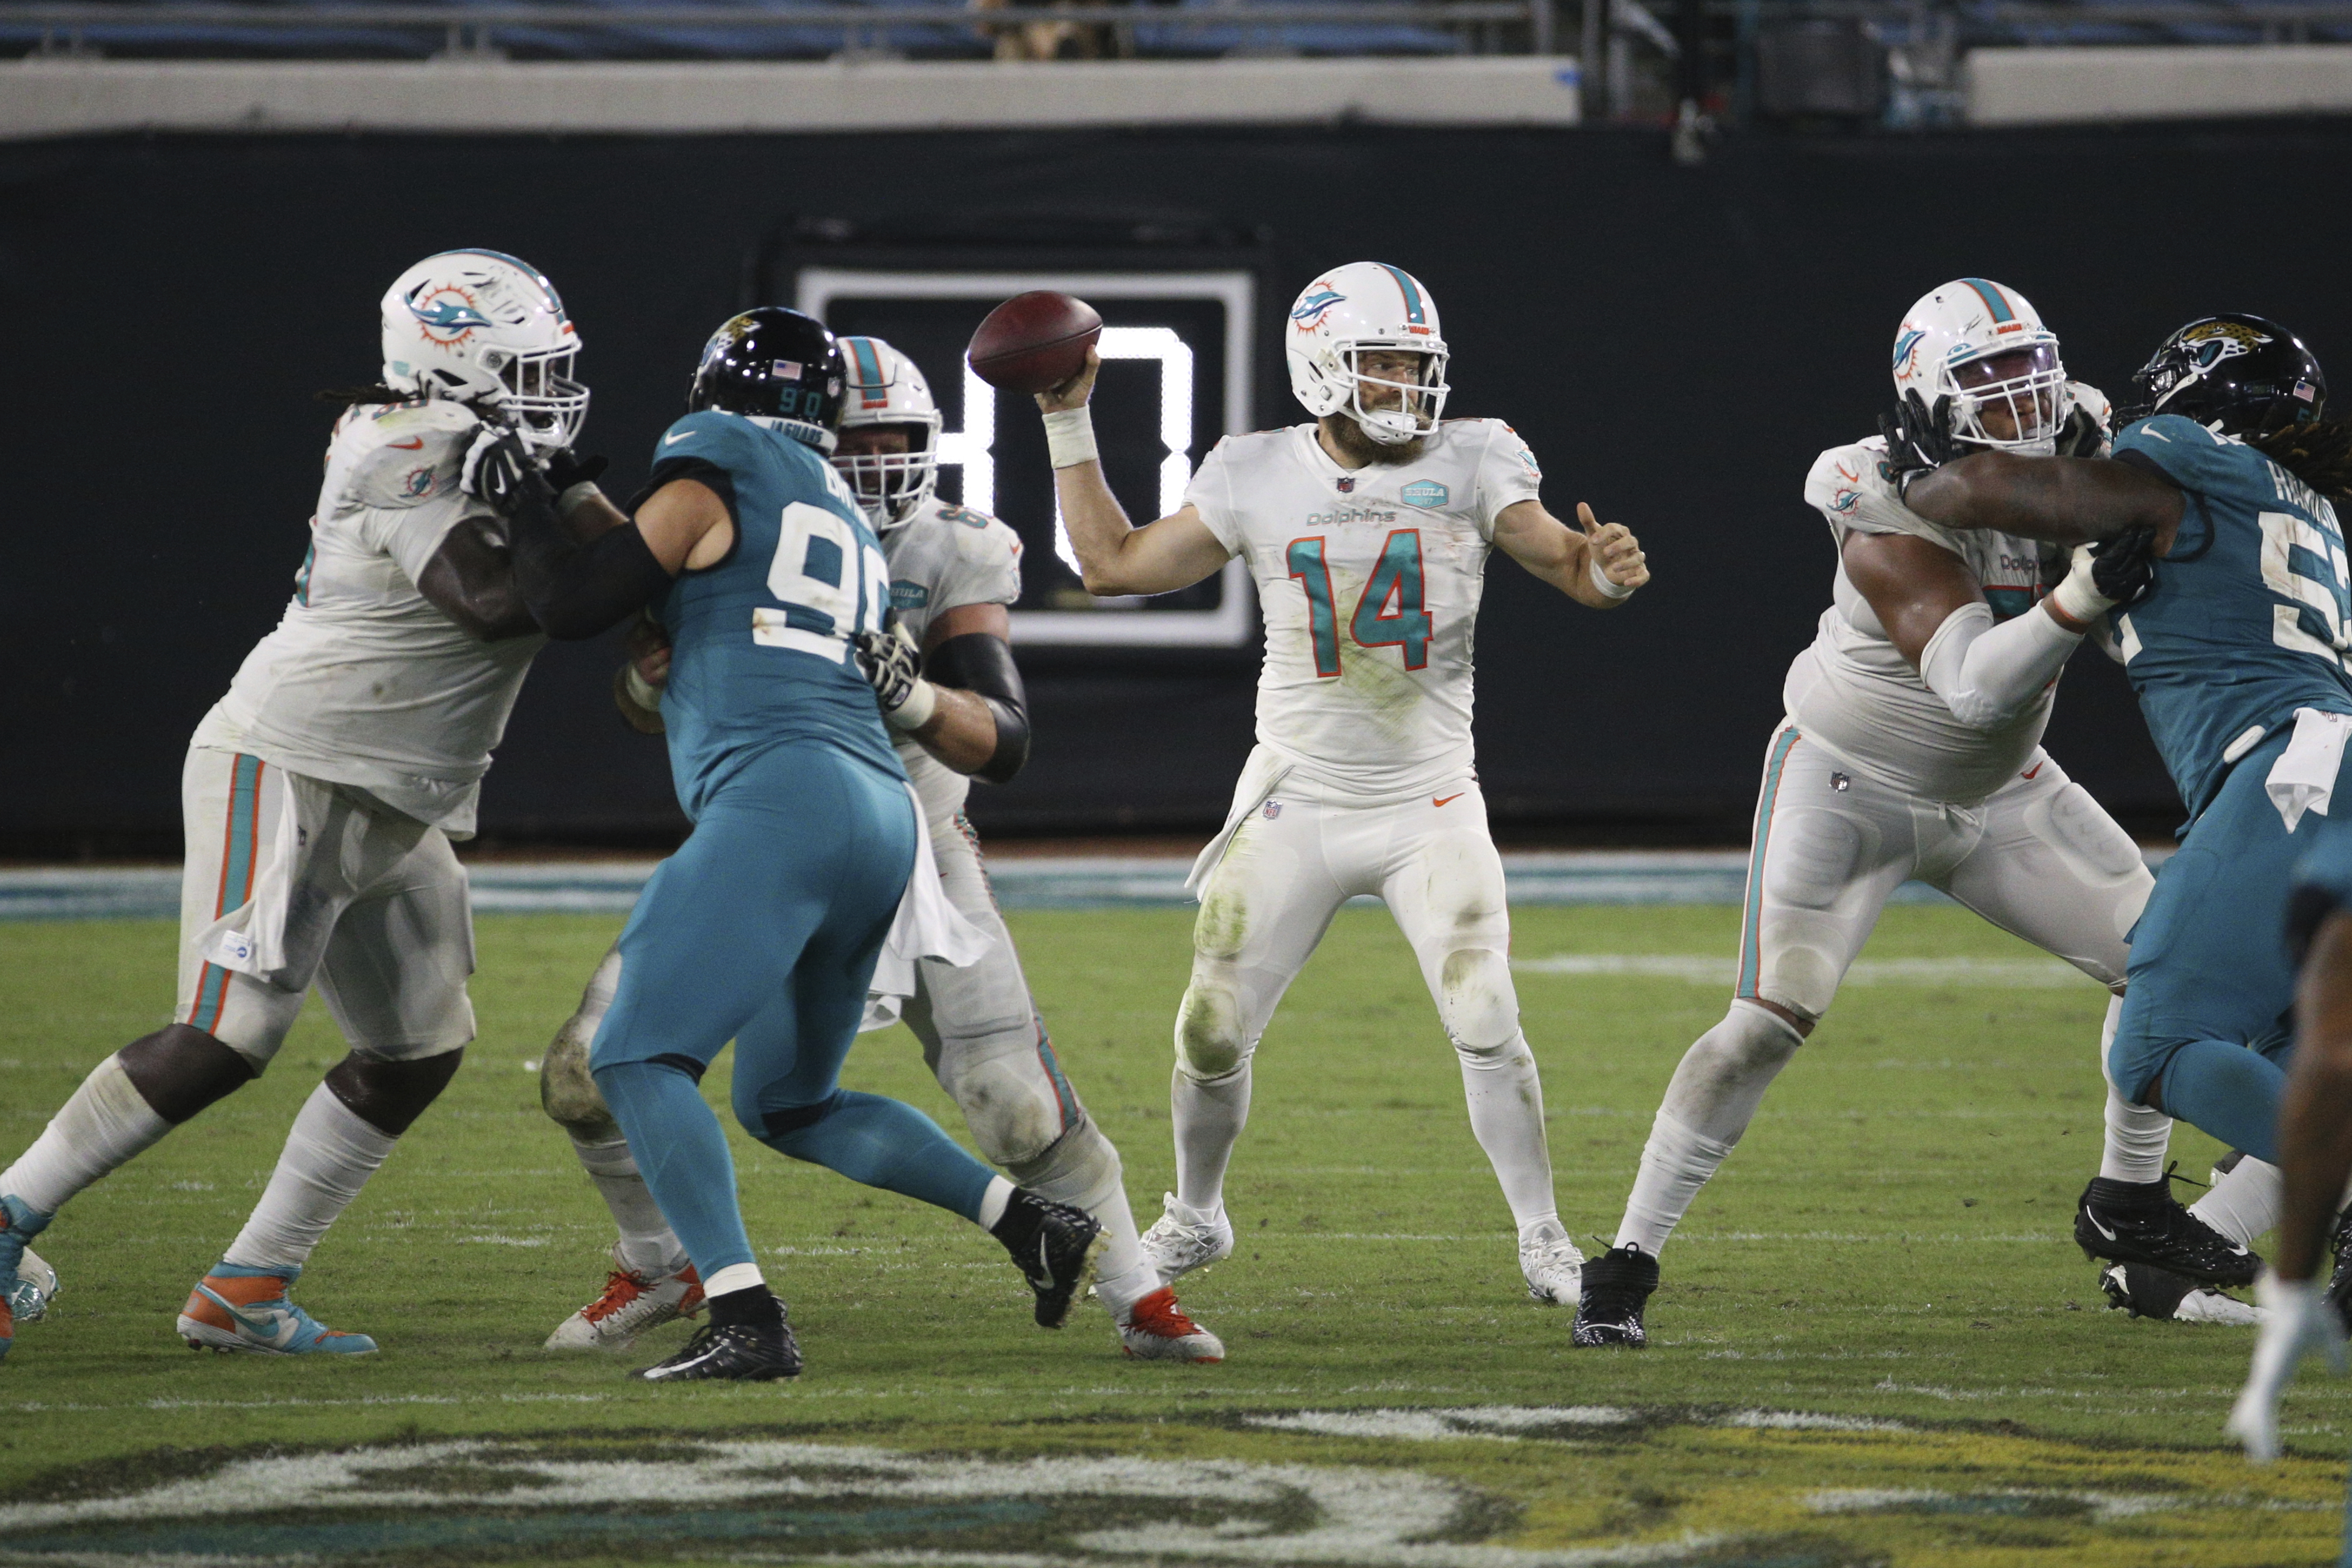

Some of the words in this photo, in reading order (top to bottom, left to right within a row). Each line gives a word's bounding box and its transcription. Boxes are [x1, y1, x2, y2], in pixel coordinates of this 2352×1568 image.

[779, 387, 822, 417] 90
[1306, 509, 1396, 526] Dolphins
[1286, 528, 1434, 678] 14
